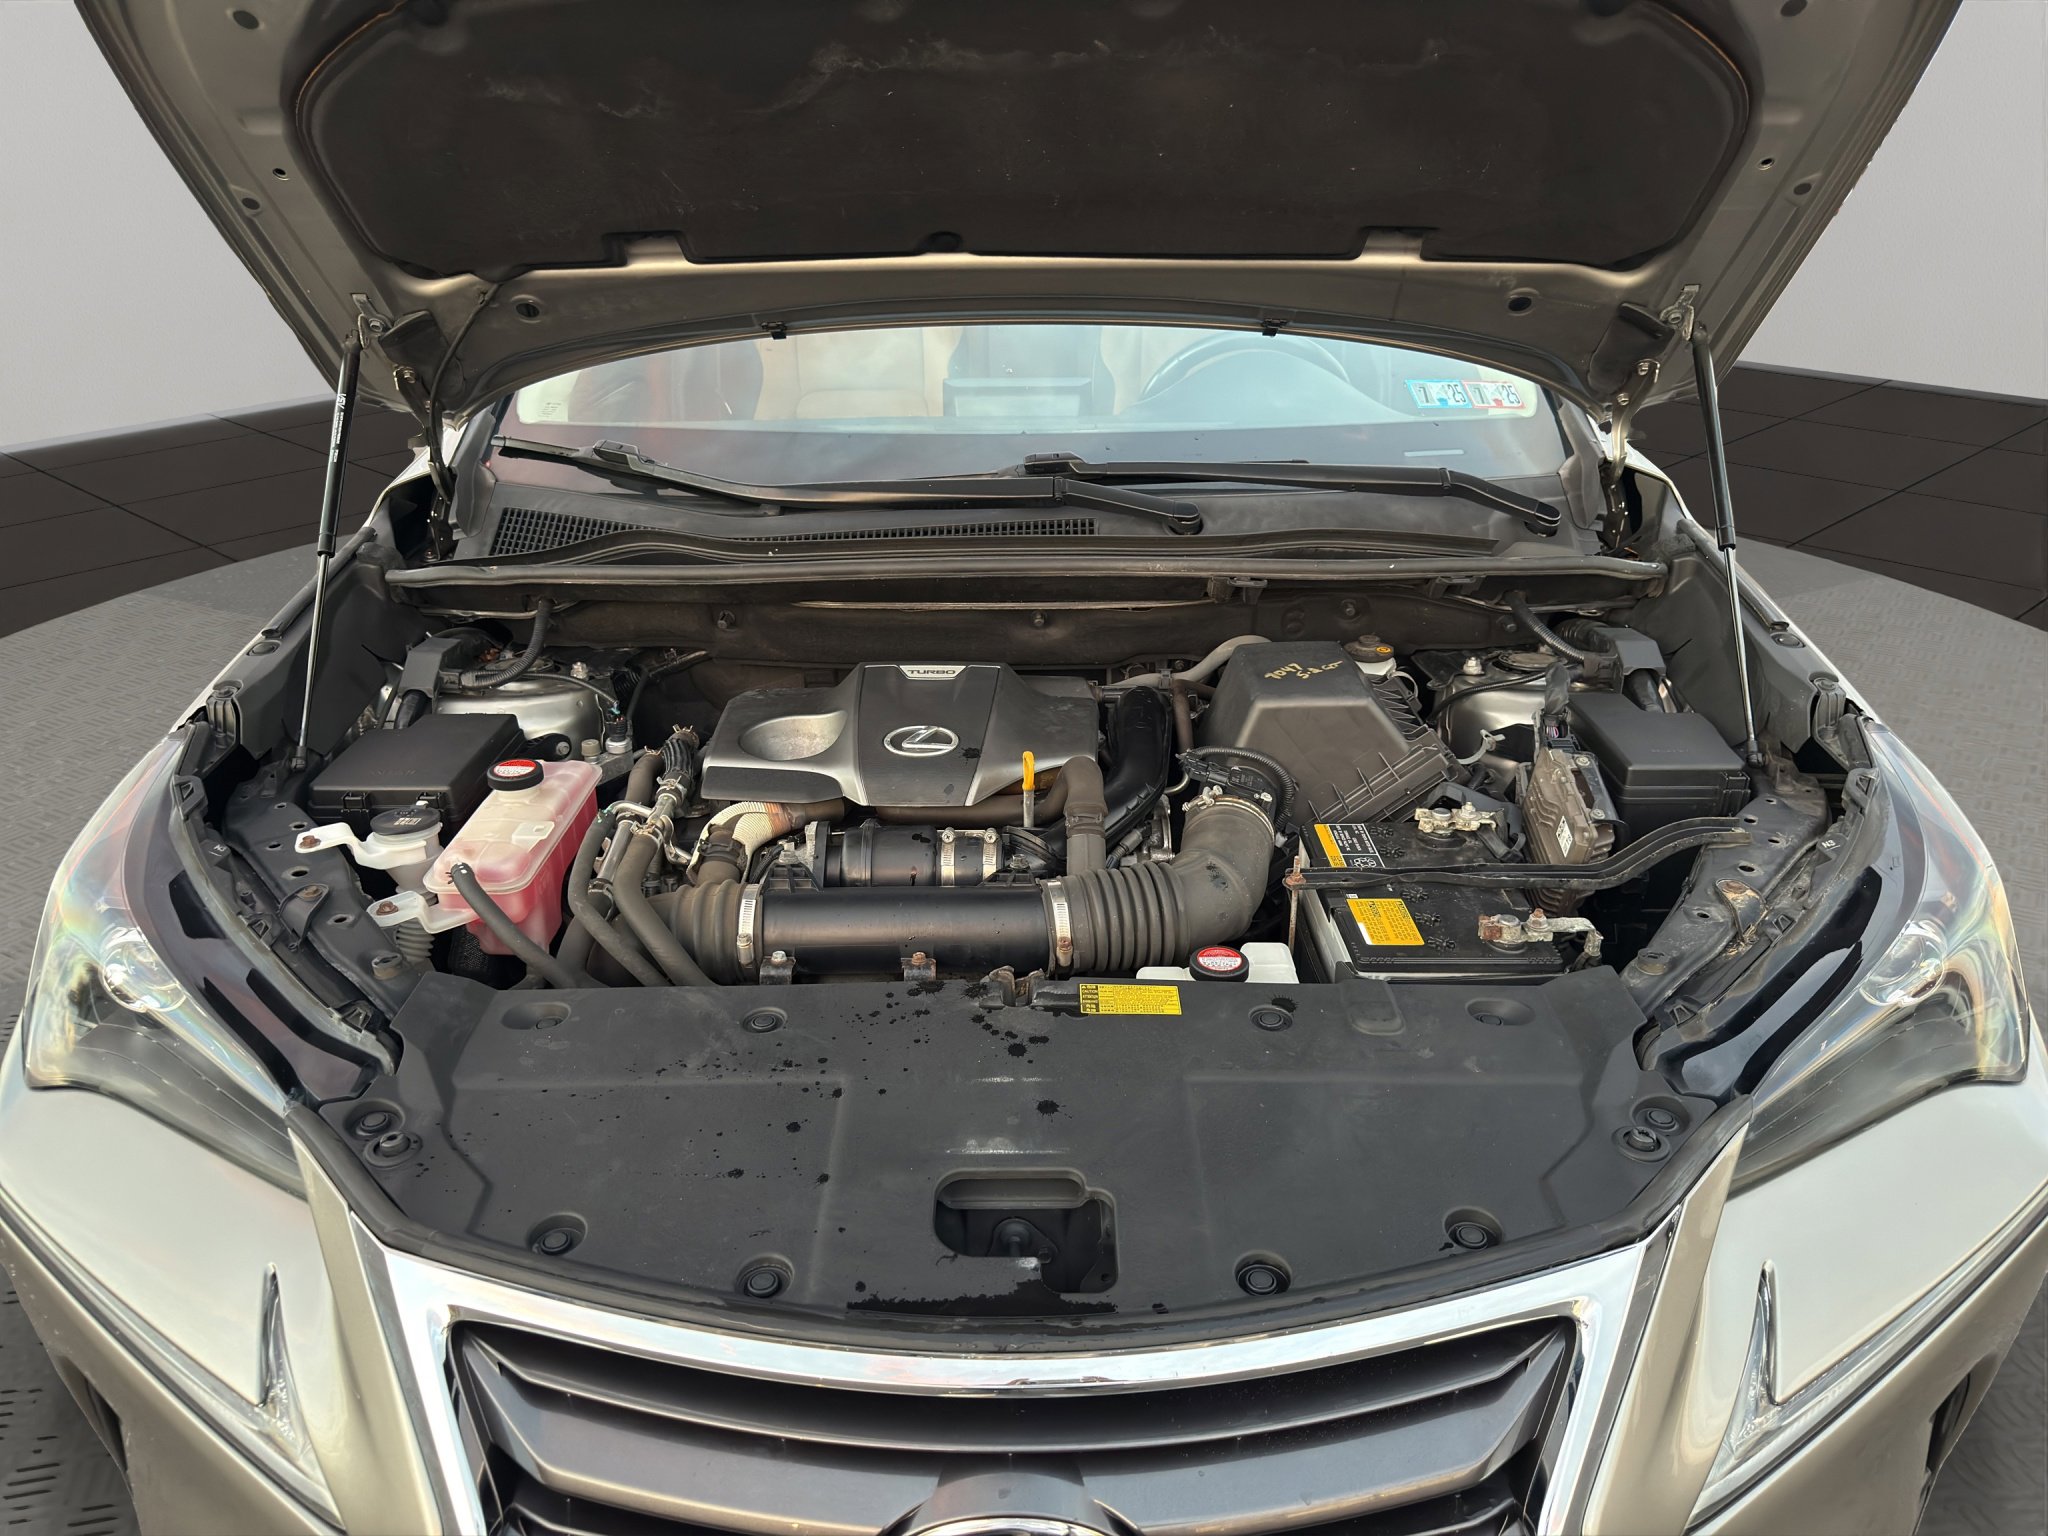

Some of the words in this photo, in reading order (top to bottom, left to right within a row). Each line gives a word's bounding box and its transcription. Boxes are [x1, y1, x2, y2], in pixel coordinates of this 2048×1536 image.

[1418, 386, 1430, 403] 7
[1447, 384, 1467, 403] 25
[1473, 386, 1485, 404] 7
[1501, 384, 1521, 404] 25
